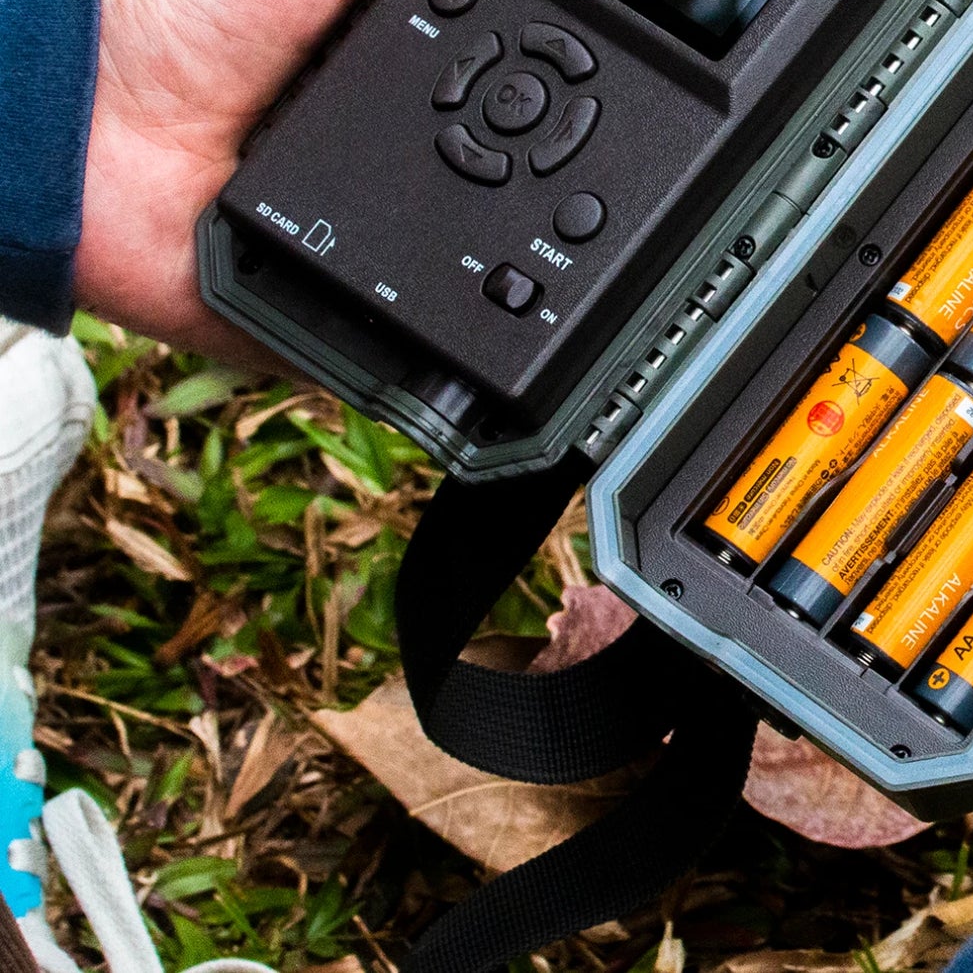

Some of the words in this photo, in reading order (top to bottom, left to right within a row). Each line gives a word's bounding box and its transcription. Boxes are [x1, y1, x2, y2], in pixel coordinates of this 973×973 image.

[408, 14, 440, 39] MENU
[495, 83, 531, 114] OK
[255, 201, 273, 218] SD
[269, 210, 300, 236] CARD
[461, 255, 484, 274] OFF
[530, 238, 573, 272] START
[374, 282, 398, 302] USB
[540, 309, 558, 325] ON
[874, 390, 928, 457] ALKALINE
[836, 507, 896, 580] AVERTISSEMENT:
[921, 457, 936, 474] pas
[932, 449, 943, 459] la
[938, 436, 953, 452] pile
[820, 525, 856, 567] CAUTION:
[901, 573, 961, 648] ALKALINE
